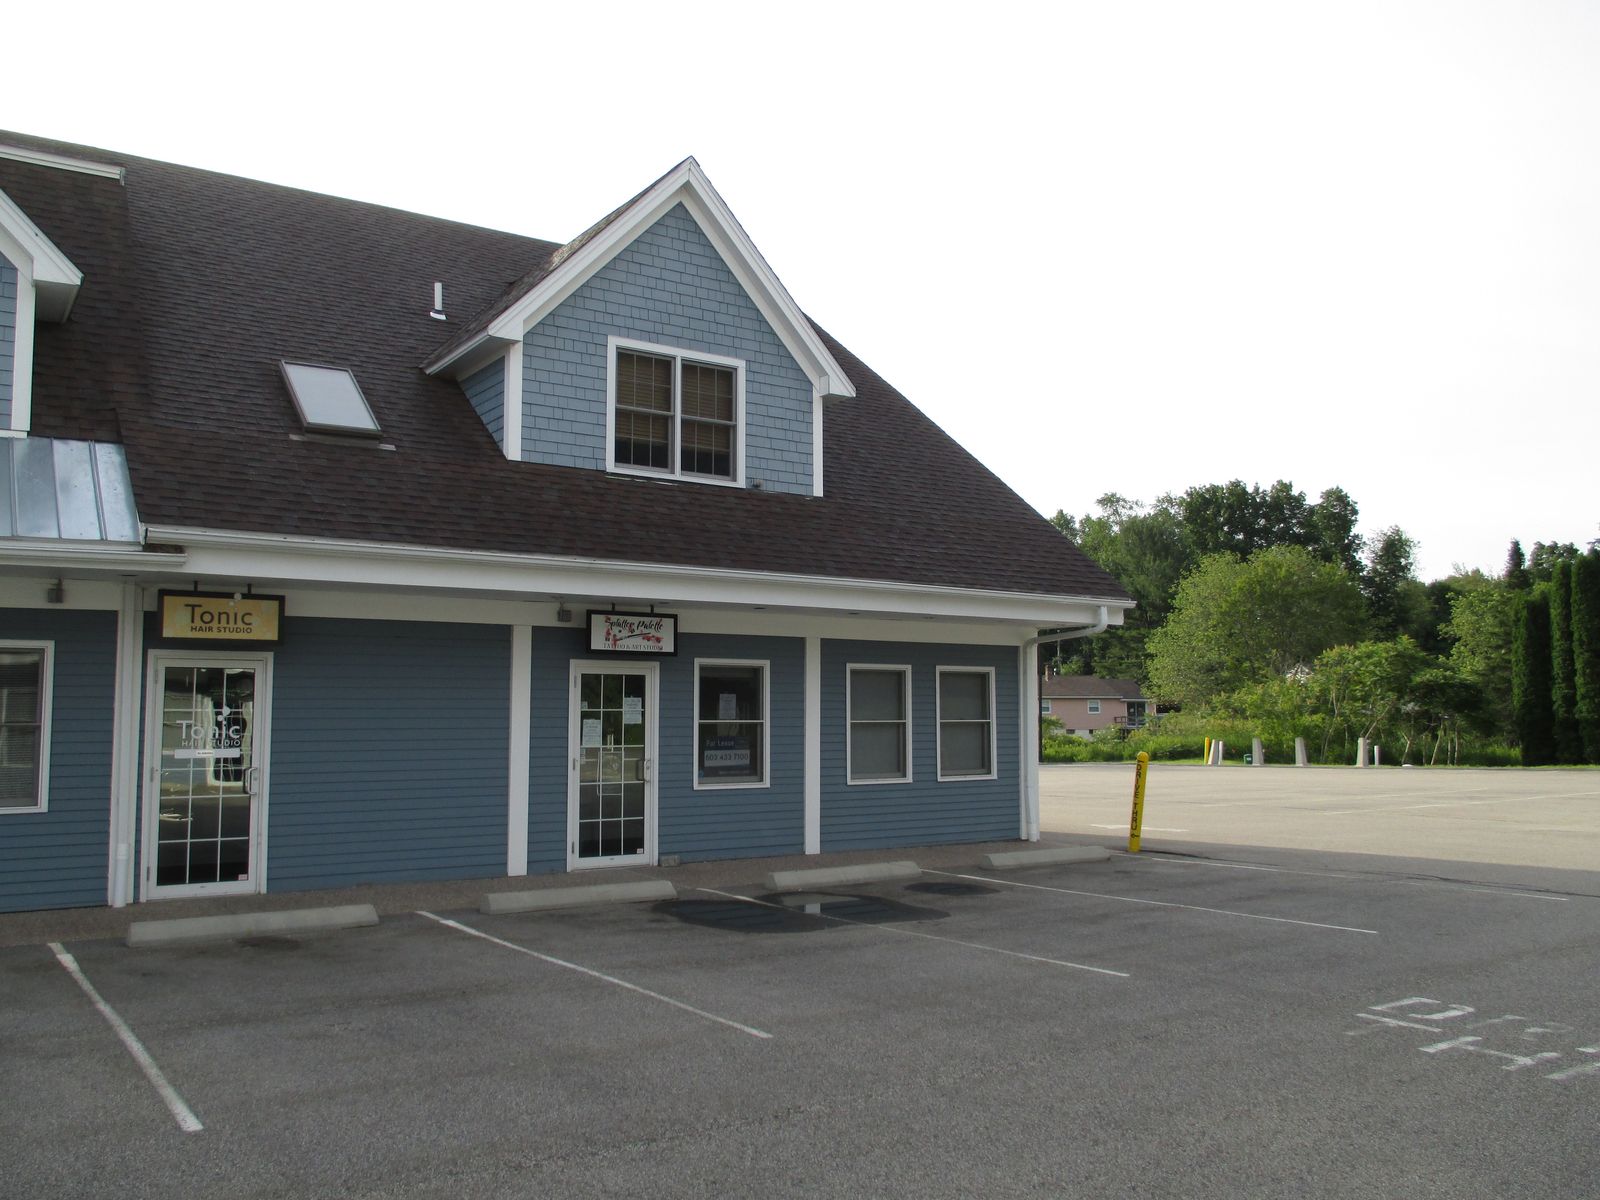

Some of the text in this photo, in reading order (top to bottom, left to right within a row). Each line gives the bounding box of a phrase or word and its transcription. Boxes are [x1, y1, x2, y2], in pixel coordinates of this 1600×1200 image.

[184, 603, 253, 625] Tonic
[191, 625, 253, 634] HAIR STUDIO
[637, 618, 664, 633] Palette
[176, 720, 241, 739] Tonic
[733, 752, 749, 761] 7100
[1130, 803, 1138, 830] THRU
